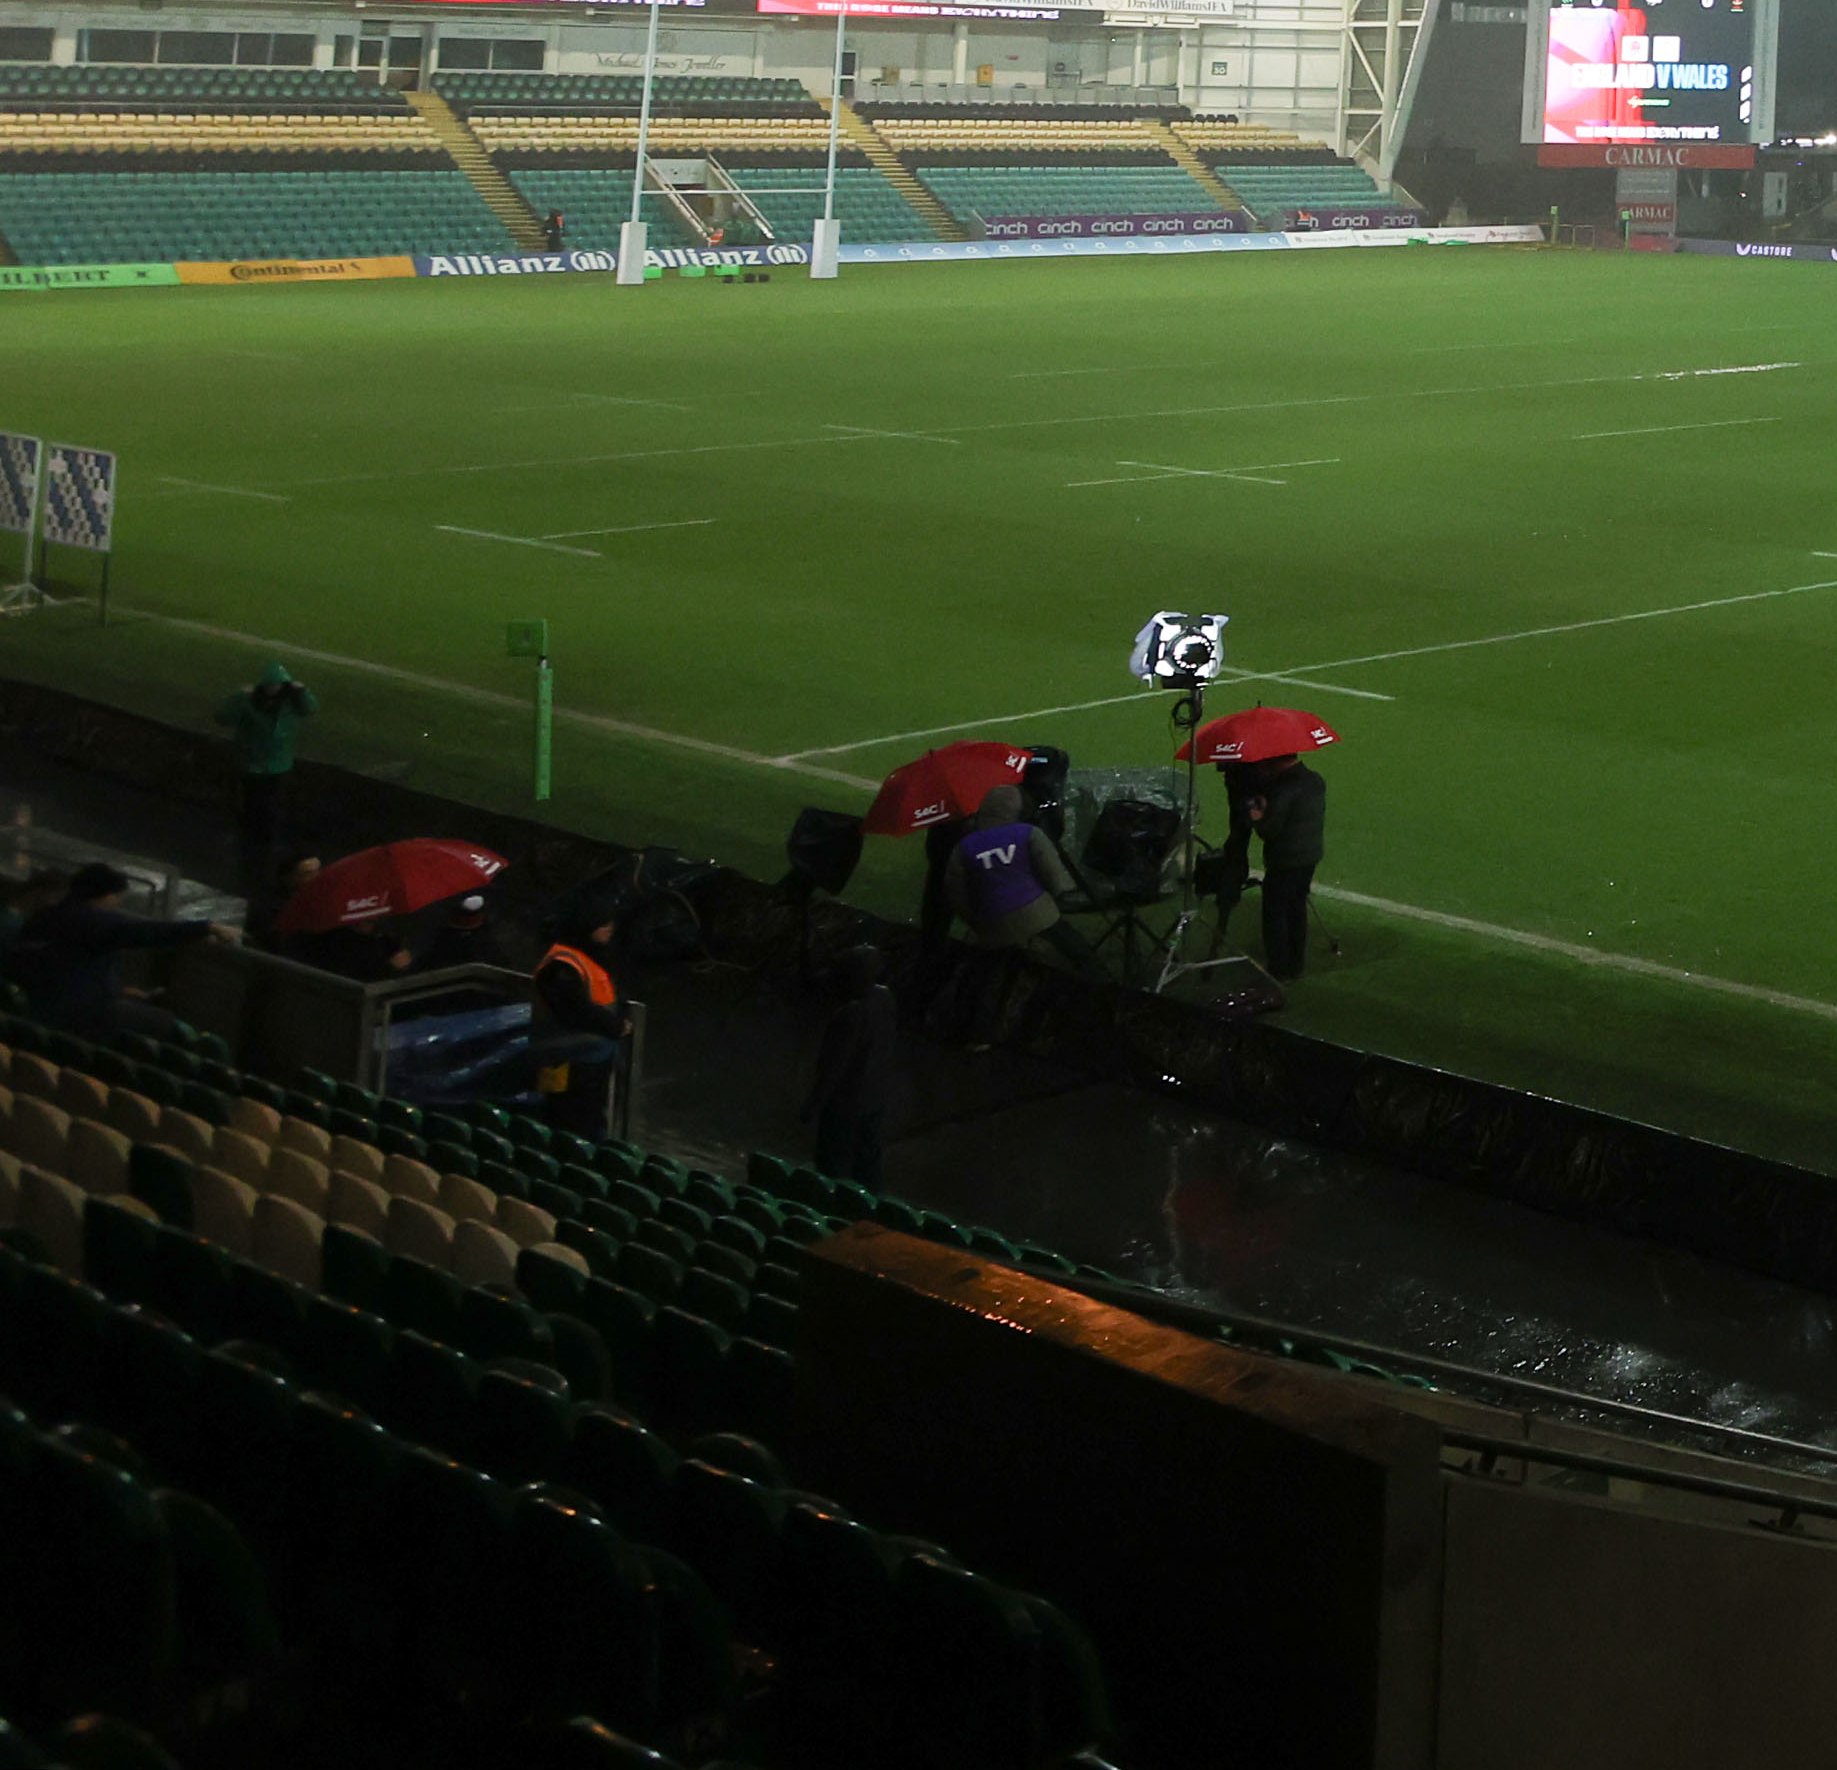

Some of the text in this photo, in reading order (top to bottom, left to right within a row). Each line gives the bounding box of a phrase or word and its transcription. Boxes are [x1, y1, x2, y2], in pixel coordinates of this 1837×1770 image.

[1656, 63, 1671, 89] V
[1672, 63, 1729, 90] WALES
[1605, 147, 1689, 166] CARMAC
[1037, 220, 1082, 234] cinch
[1091, 219, 1136, 233] cinch
[1143, 218, 1185, 232] cinch
[1193, 217, 1233, 231] cinch
[1332, 214, 1370, 228] cinch
[643, 245, 762, 267] Allianz
[1750, 245, 1793, 257] CASTORE
[229, 262, 345, 281] Continental
[430, 253, 566, 276] Allianz
[976, 843, 1016, 869] TV
